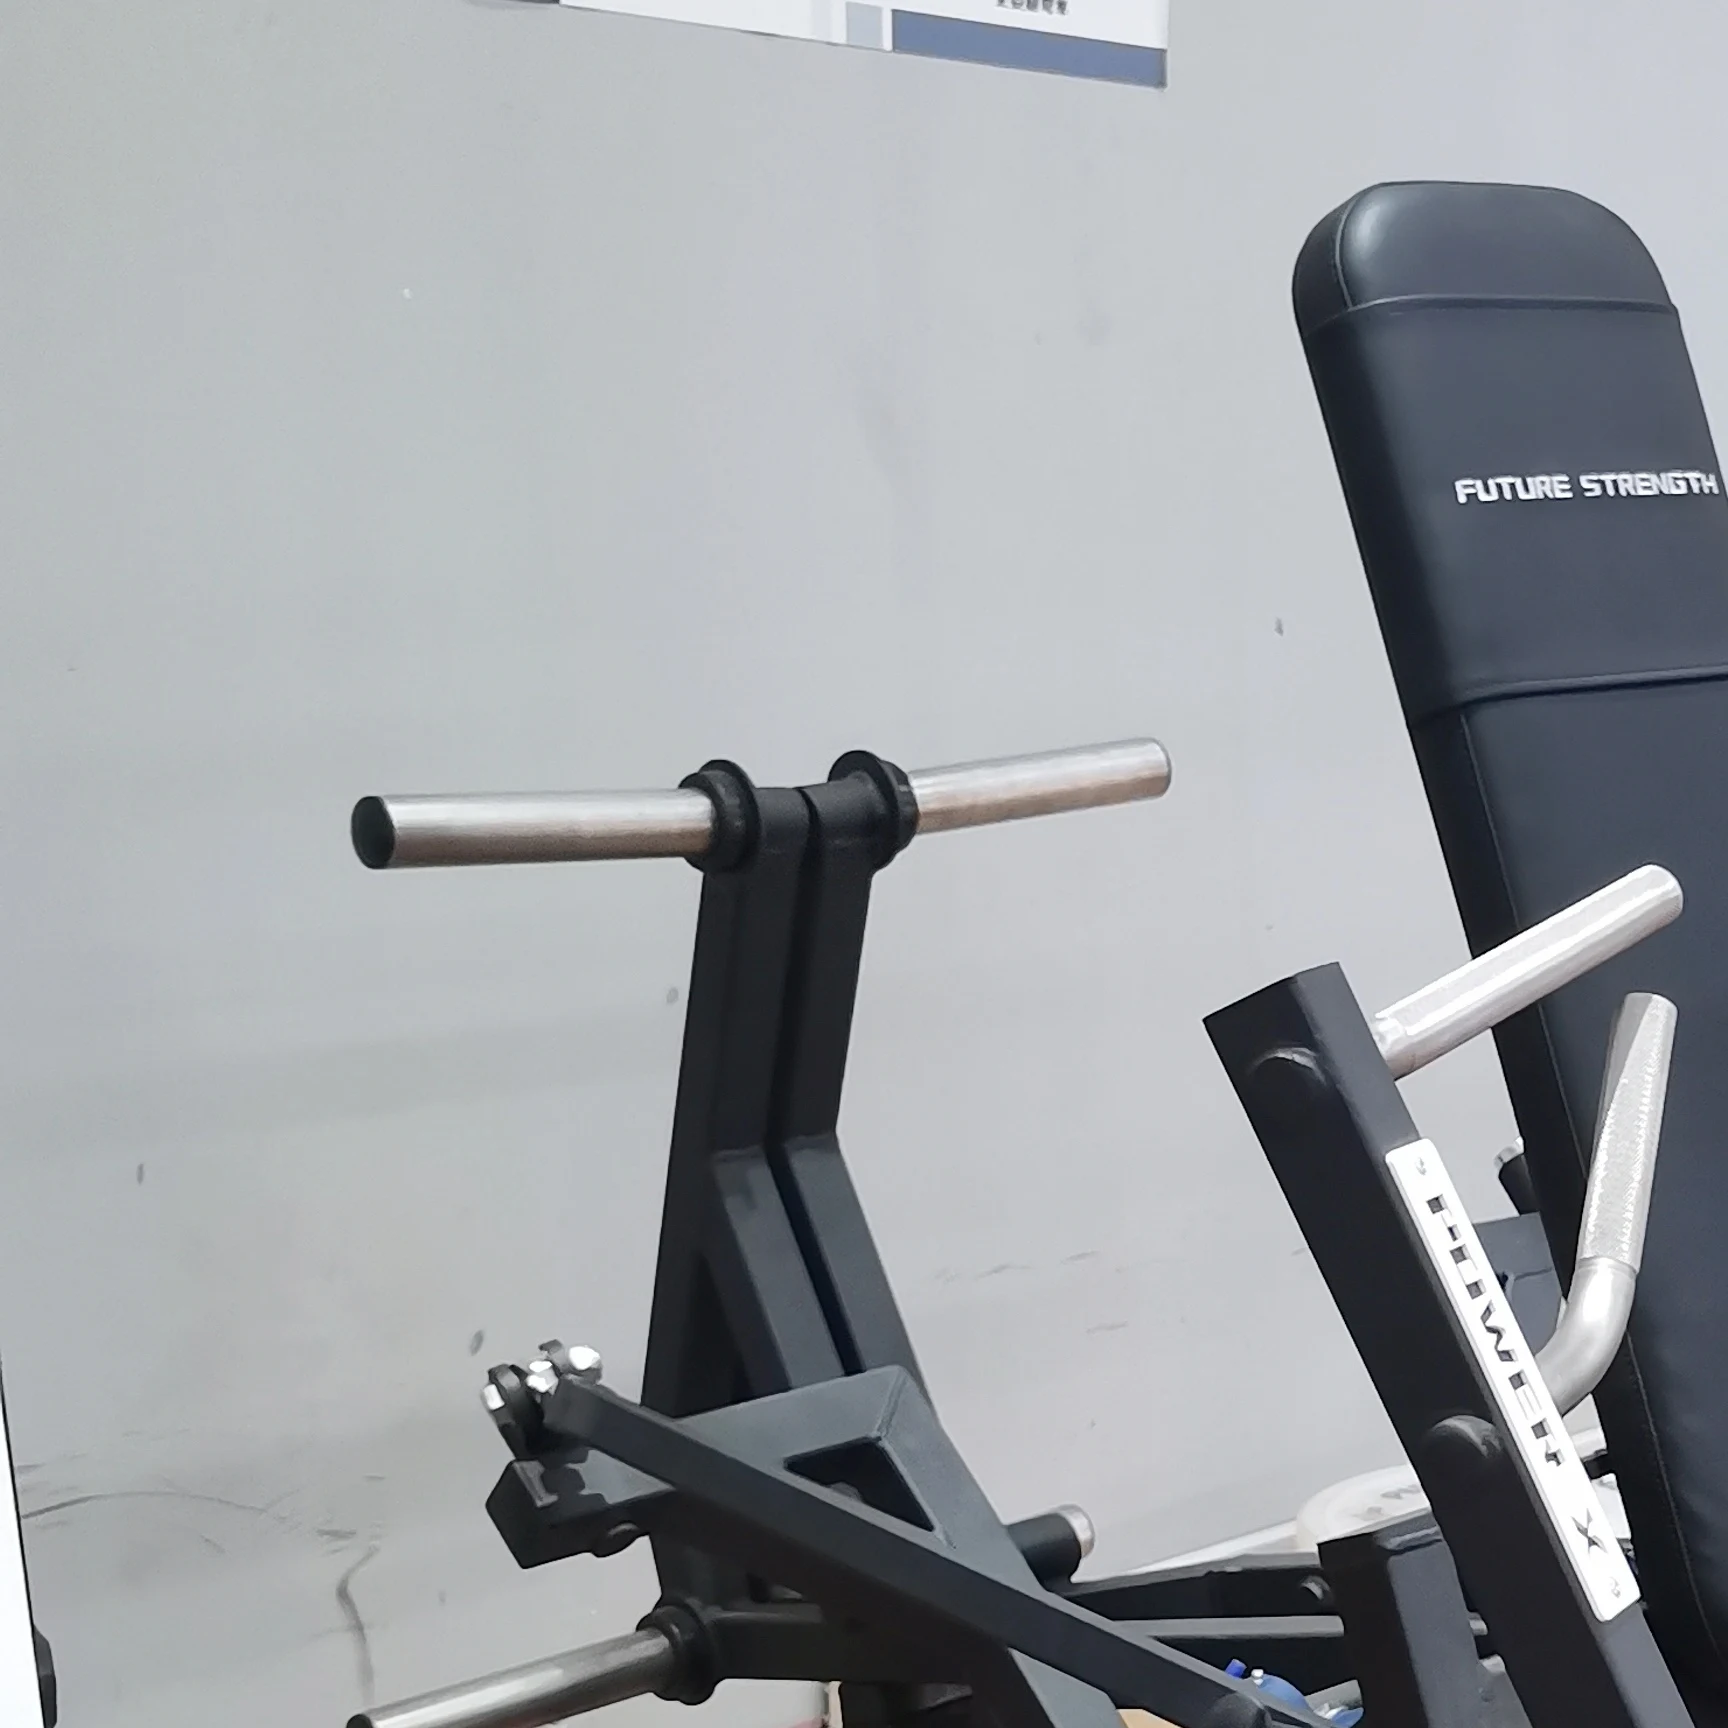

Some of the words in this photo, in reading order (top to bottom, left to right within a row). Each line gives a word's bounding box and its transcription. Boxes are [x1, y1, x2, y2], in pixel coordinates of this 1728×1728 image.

[1455, 474, 1573, 504] FUTURE
[1579, 471, 1719, 498] STRENGTH
[1571, 1508, 1608, 1553] X
